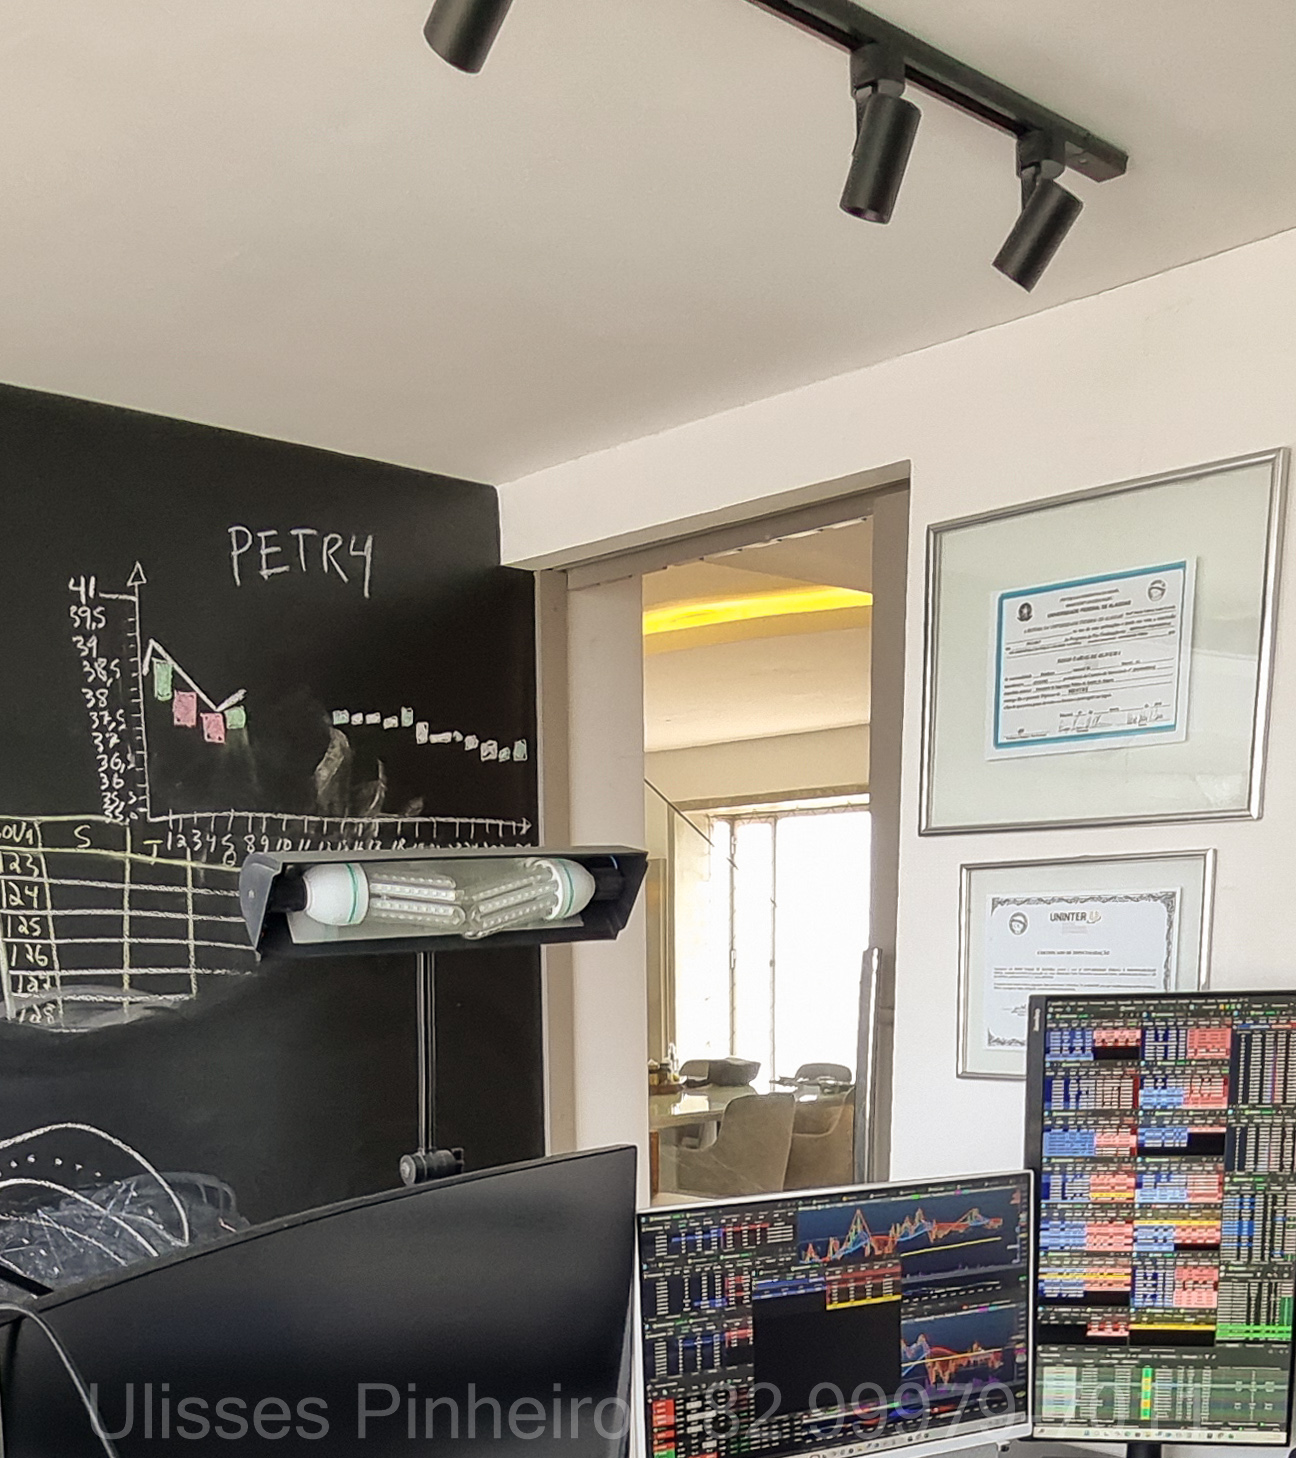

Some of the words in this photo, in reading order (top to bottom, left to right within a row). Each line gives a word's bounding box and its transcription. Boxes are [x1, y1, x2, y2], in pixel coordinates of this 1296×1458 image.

[69, 605, 106, 631] 39,5
[82, 658, 121, 687] 38,5
[82, 688, 108, 709] 38
[99, 772, 125, 790] 36
[1, 880, 39, 909] 124
[7, 916, 42, 937] 125
[1049, 911, 1087, 922] UNINTER
